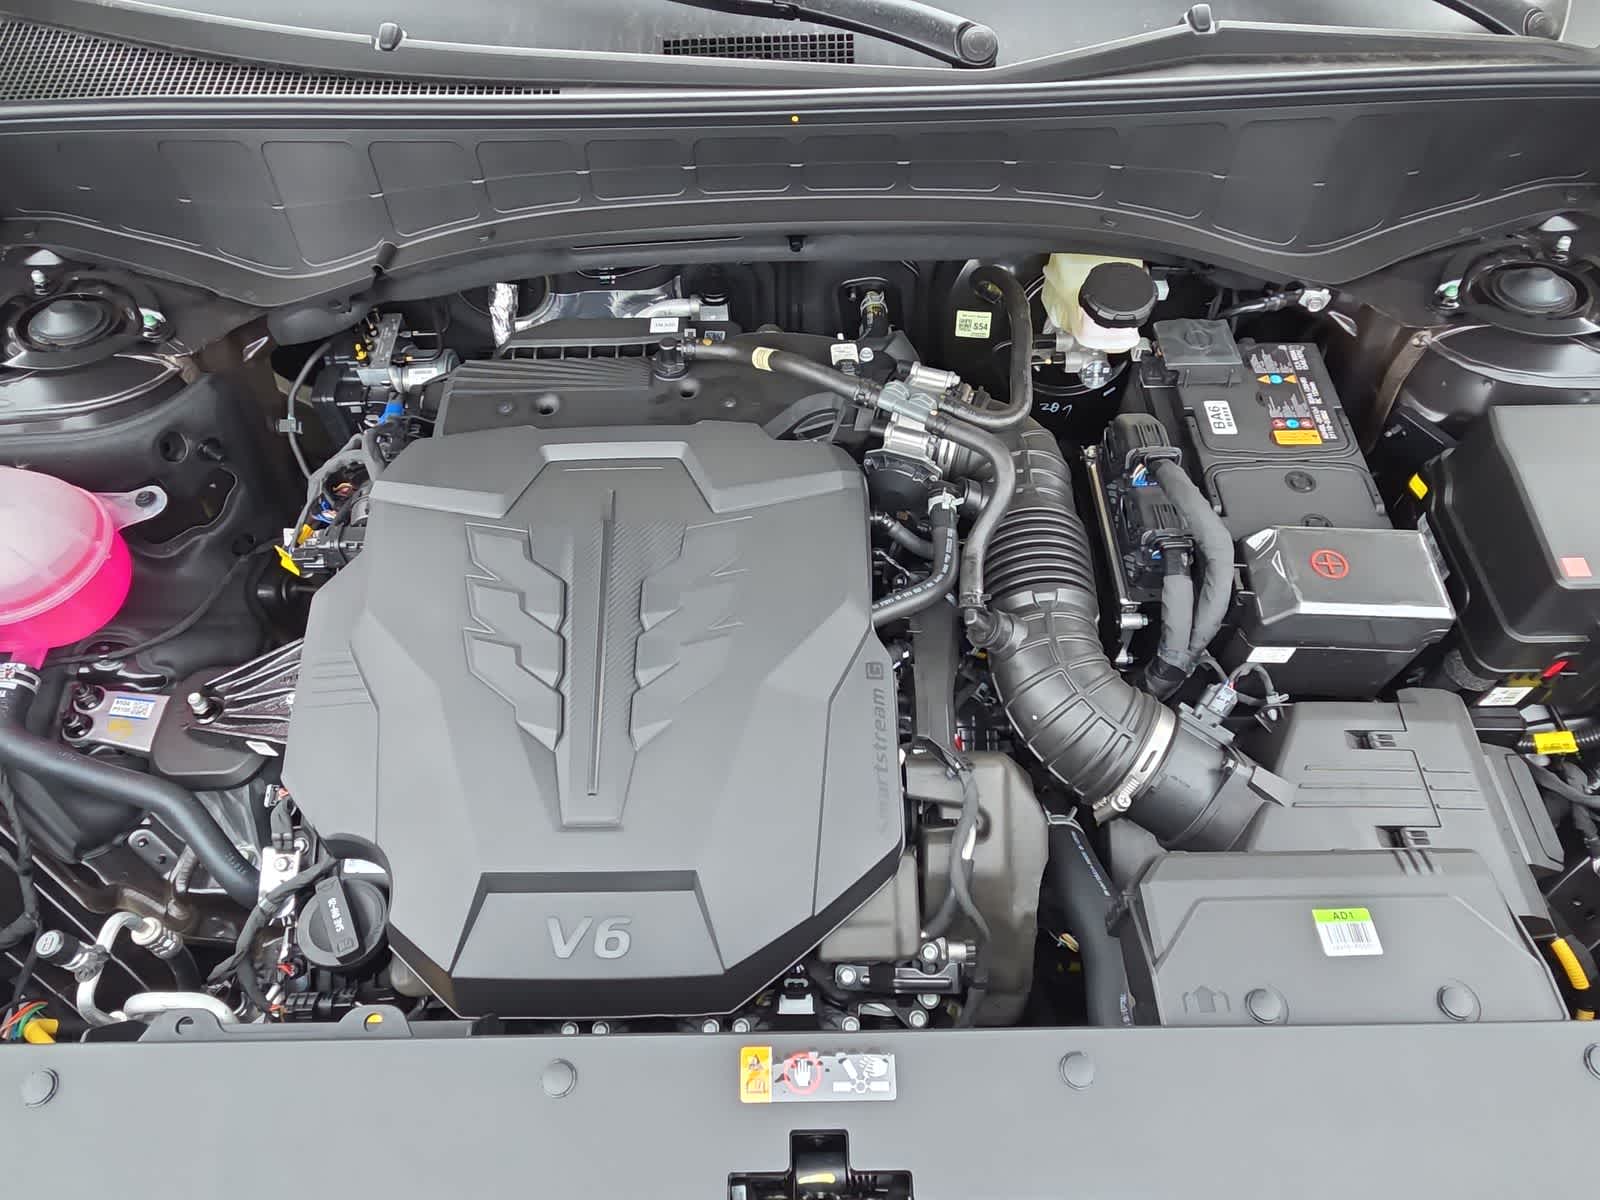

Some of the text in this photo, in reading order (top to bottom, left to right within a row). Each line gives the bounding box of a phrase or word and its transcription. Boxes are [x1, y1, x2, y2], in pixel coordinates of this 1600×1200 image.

[1209, 405, 1226, 430] BA6
[1333, 911, 1355, 921] AD1
[546, 915, 633, 959] V6
